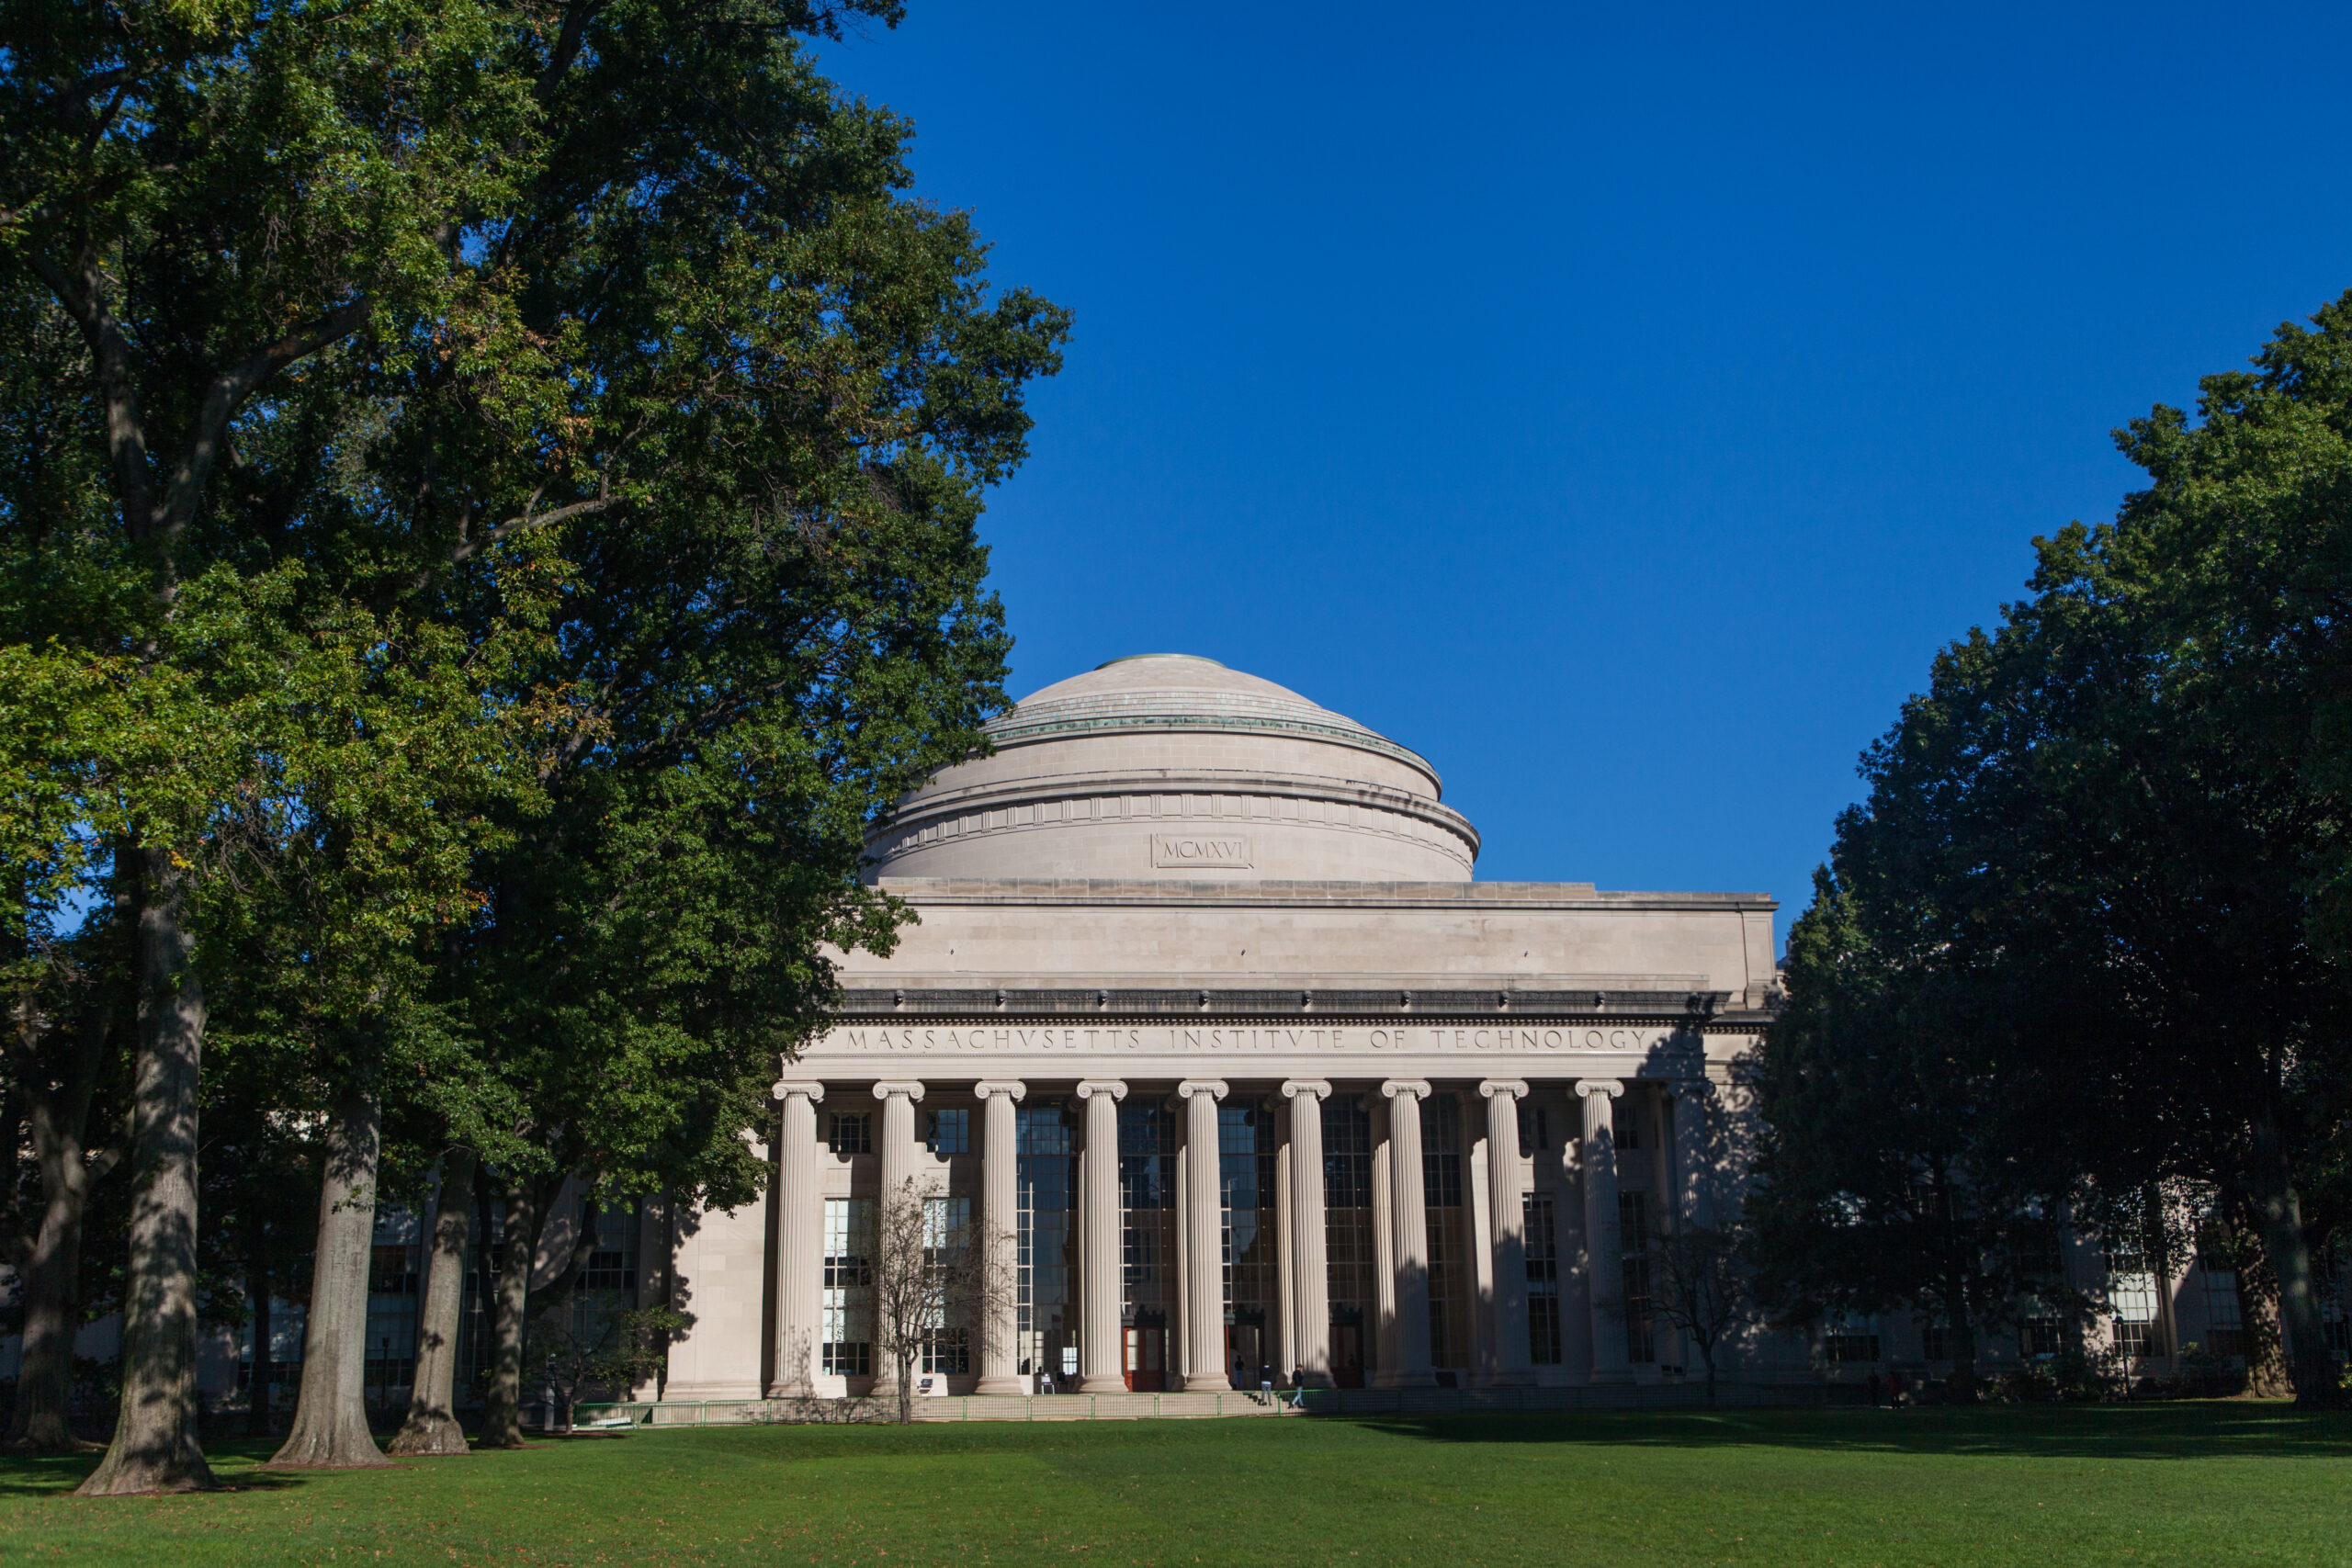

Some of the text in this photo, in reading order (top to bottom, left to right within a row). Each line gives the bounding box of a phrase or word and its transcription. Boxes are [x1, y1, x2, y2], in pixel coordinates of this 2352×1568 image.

[1163, 841, 1242, 859] MCMXVI
[845, 1029, 1646, 1050] MASSACHVSETTS INSTITVTE OF TECHNOLOGY
